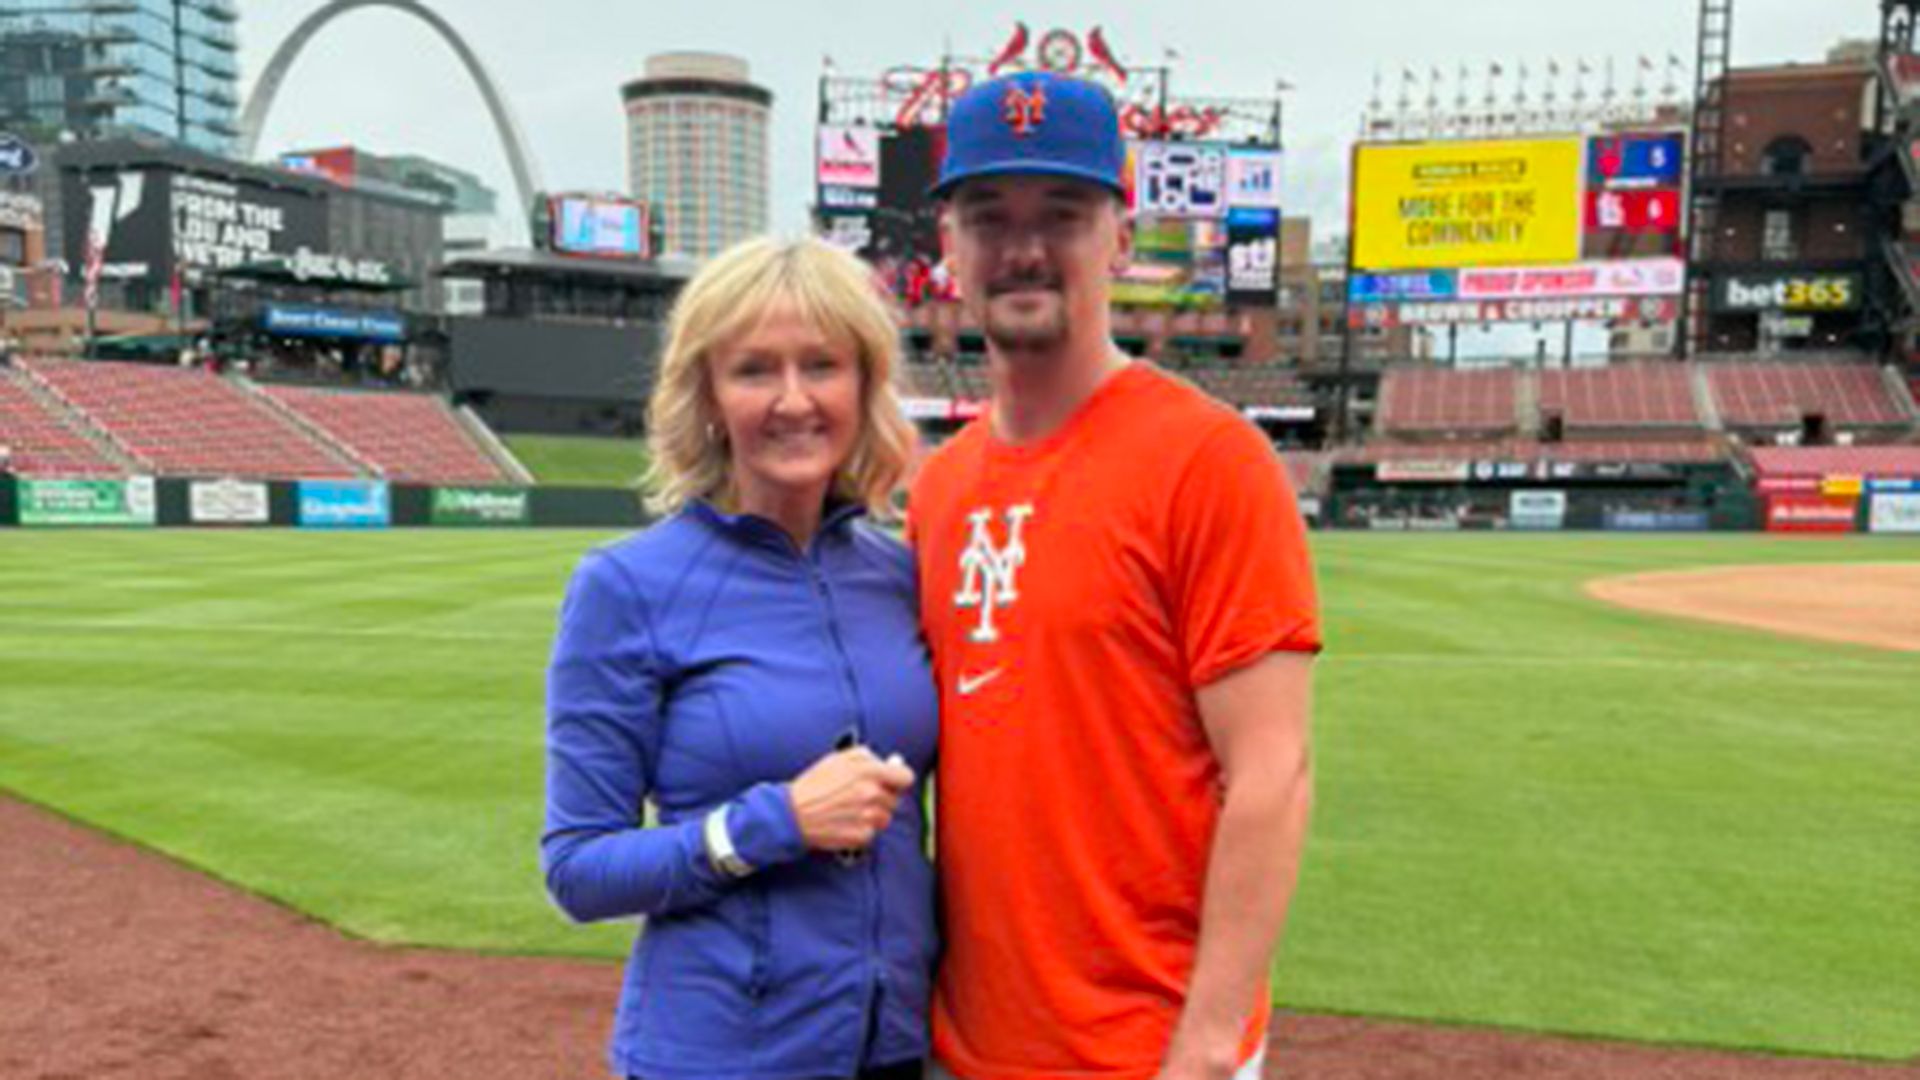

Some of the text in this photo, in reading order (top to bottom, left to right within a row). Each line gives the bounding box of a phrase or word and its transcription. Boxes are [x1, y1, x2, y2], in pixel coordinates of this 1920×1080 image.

[170, 191, 285, 231] FROM THE
[171, 217, 270, 251] LOU AND
[1727, 278, 1851, 307] bet365
[953, 506, 1034, 643] NY
